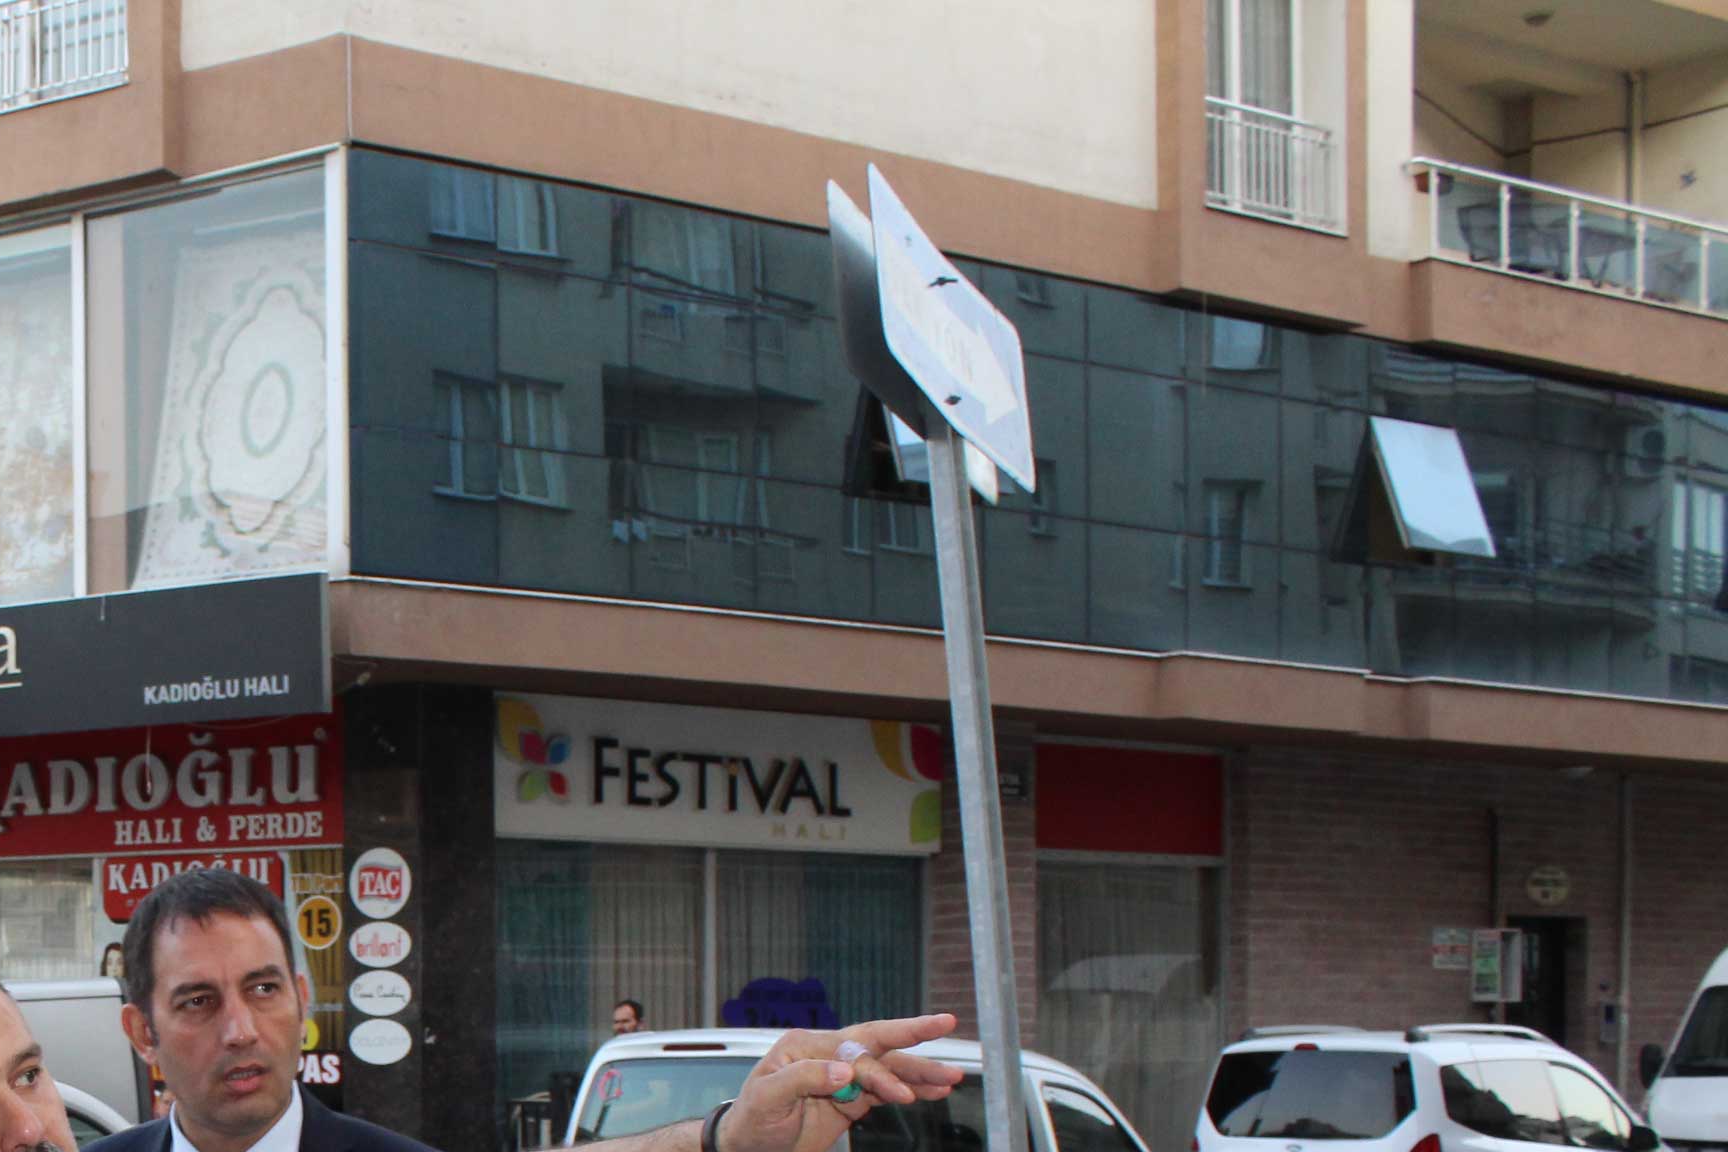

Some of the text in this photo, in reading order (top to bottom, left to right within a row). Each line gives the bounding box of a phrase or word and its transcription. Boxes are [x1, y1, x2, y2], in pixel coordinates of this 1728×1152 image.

[144, 674, 290, 705] KADIOĞLU HALI
[113, 811, 324, 846] HALI & PERDE
[303, 909, 332, 938] 15
